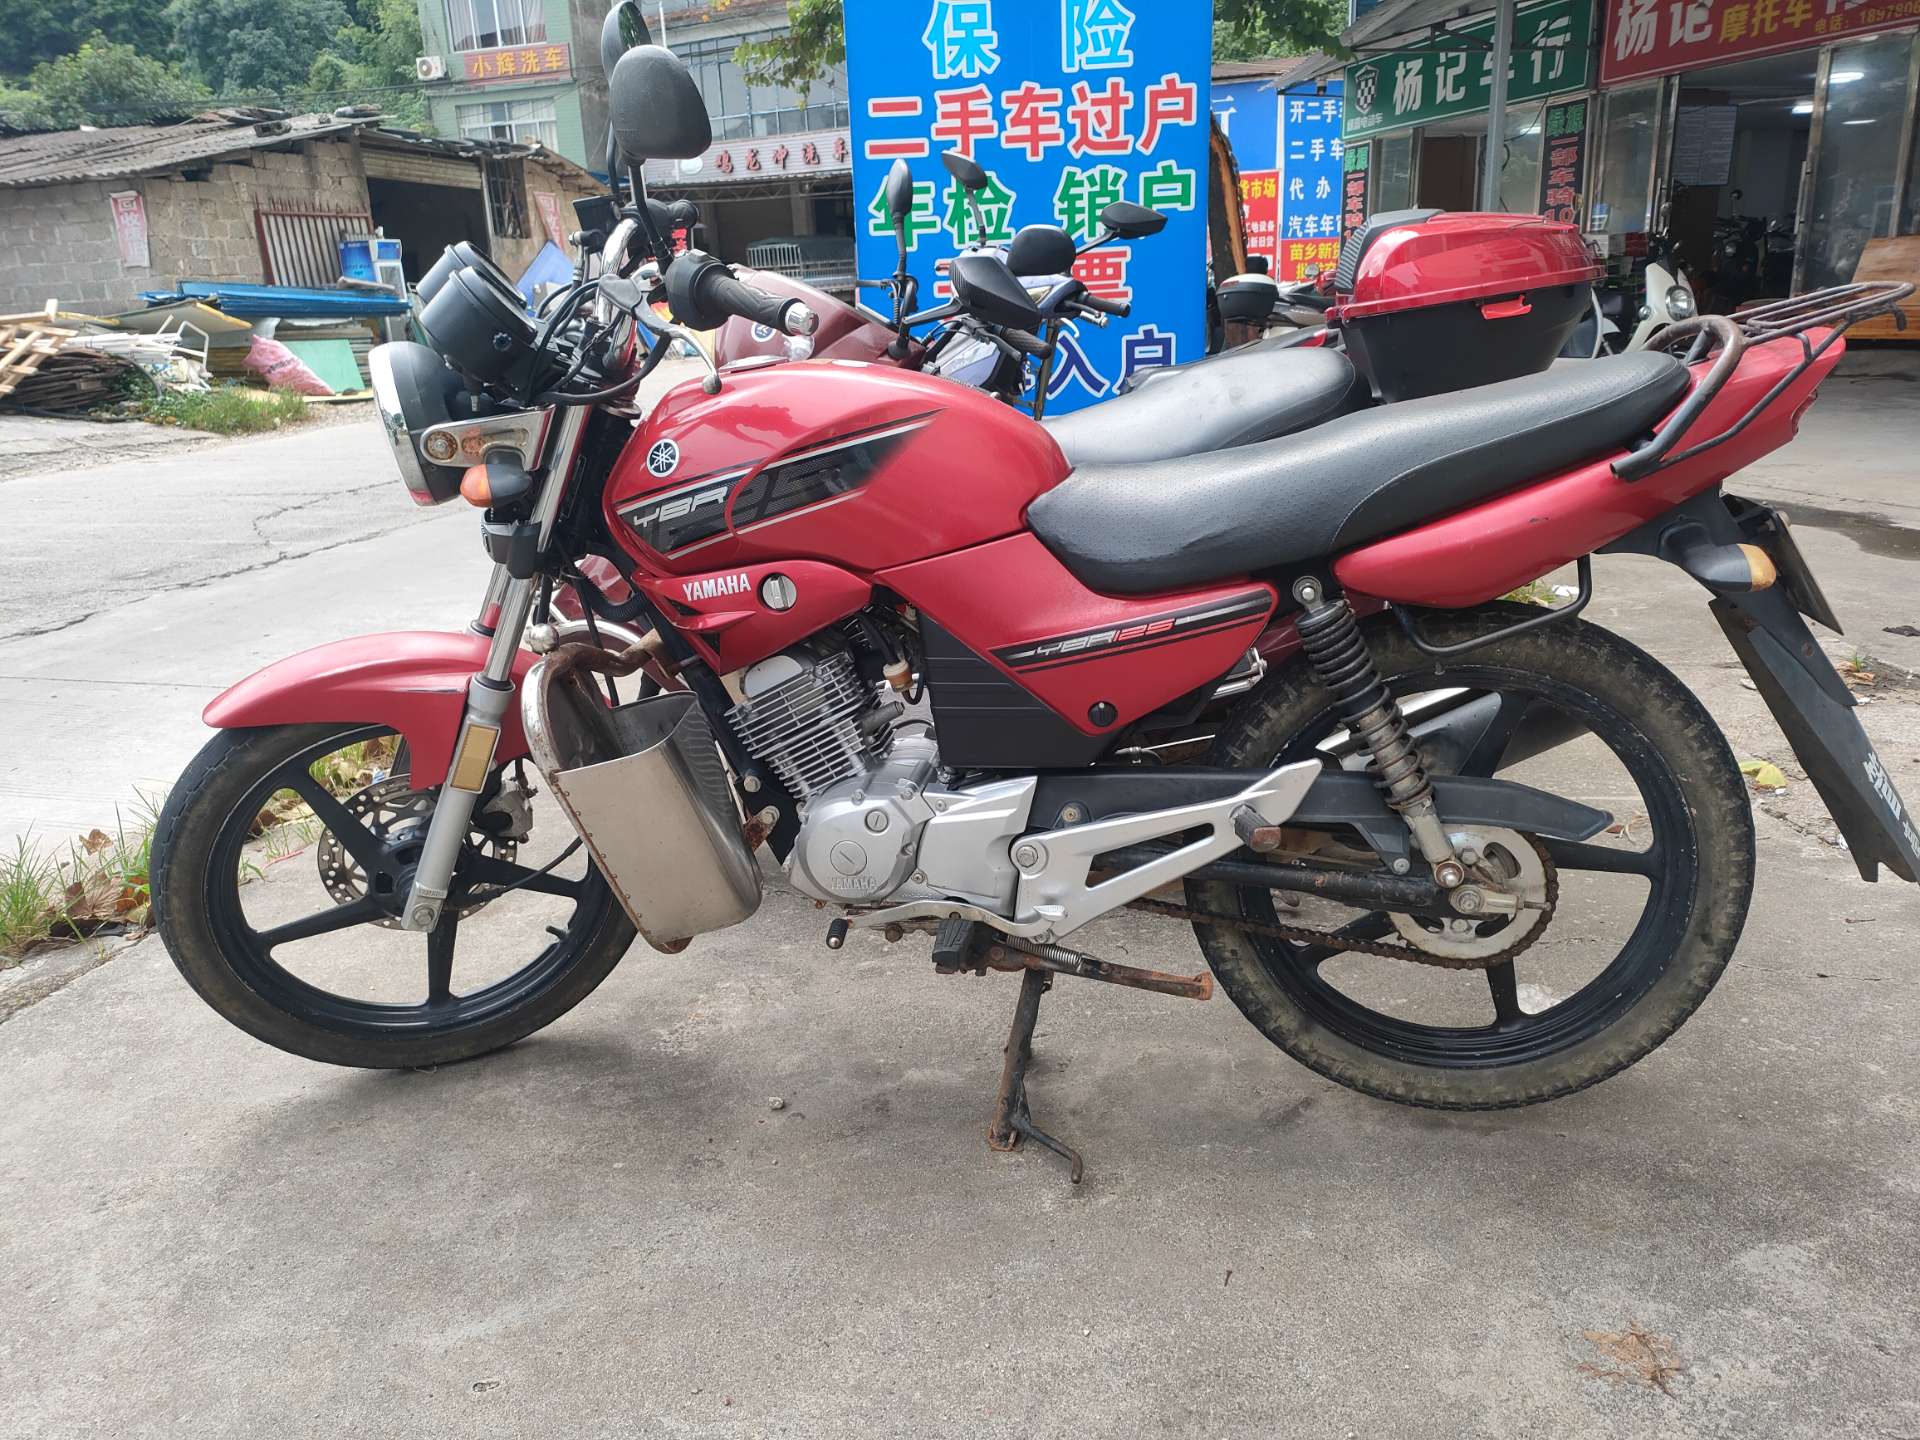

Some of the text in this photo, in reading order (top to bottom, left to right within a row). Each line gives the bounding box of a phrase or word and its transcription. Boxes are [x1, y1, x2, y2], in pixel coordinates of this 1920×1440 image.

[924, 0, 1134, 75] 保险
[1614, 0, 1813, 61] 杨记 摩托车
[472, 46, 564, 77] 小辉洗车
[867, 74, 1196, 158] 二手车过户
[1290, 138, 1344, 162] 二手车
[870, 160, 1196, 249] 年检 销户
[1289, 176, 1331, 200] 代办
[1246, 235, 1275, 248] 新旧货
[1020, 325, 1176, 398] 入户
[633, 486, 729, 528] YBR
[682, 573, 752, 602] YAMAHA
[1034, 618, 1175, 657] YBR125
[830, 876, 879, 891] YAMAHA
